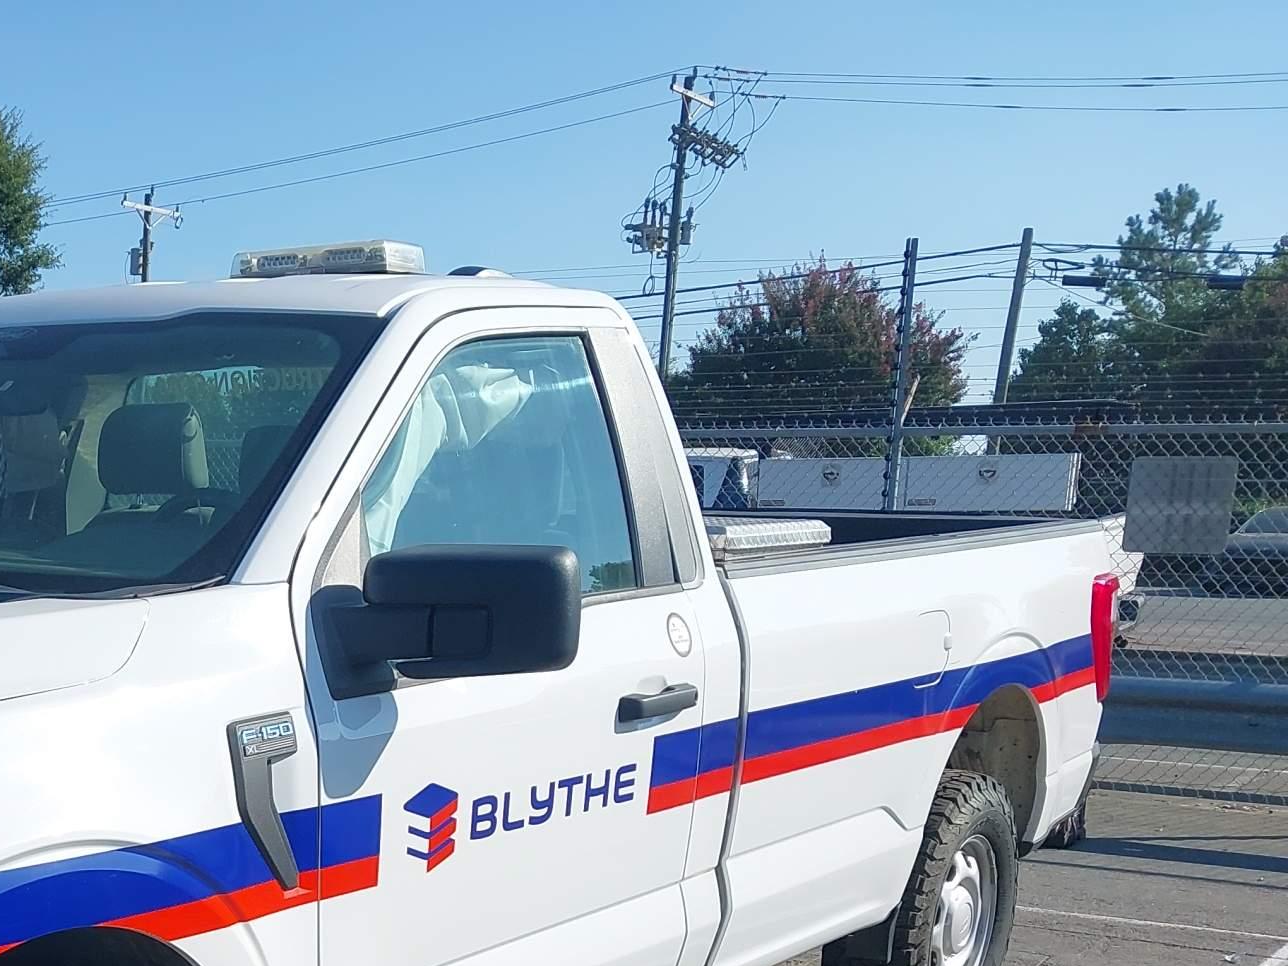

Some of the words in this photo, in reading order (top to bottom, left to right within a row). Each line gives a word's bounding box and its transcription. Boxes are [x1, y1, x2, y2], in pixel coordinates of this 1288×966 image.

[242, 722, 294, 745] F-150
[244, 745, 258, 756] XL
[470, 763, 637, 840] BLYTHE
